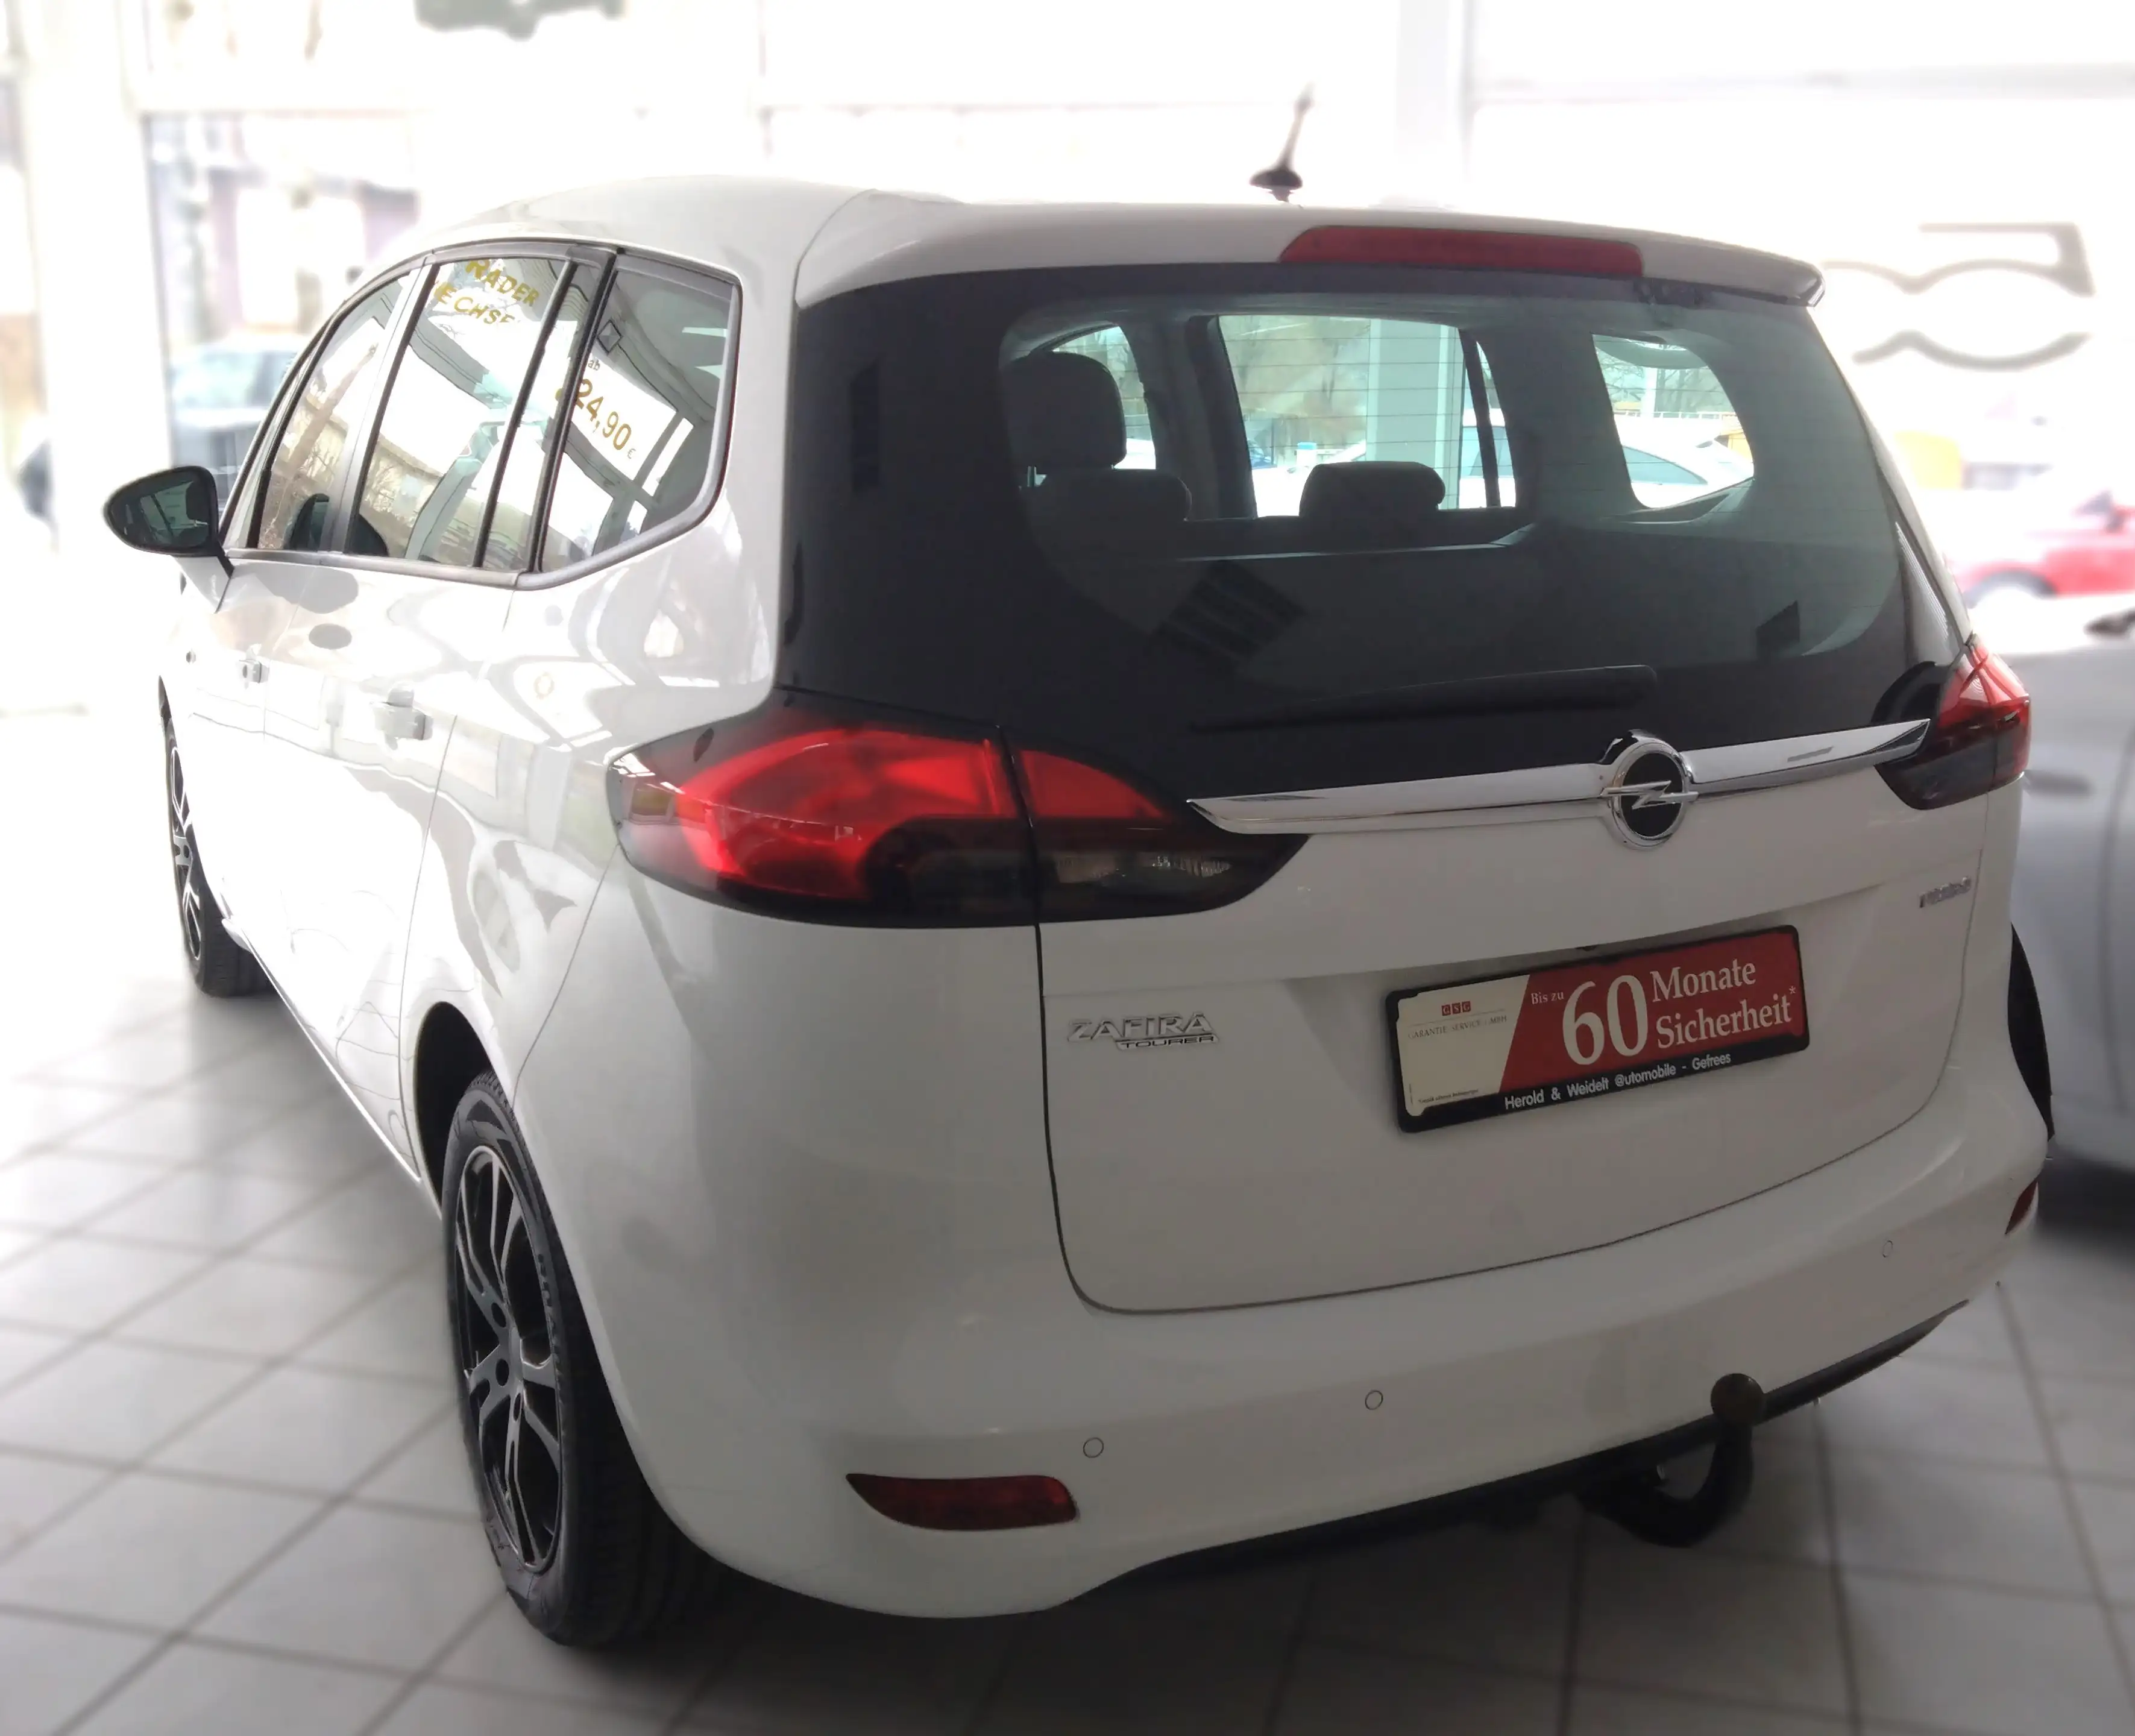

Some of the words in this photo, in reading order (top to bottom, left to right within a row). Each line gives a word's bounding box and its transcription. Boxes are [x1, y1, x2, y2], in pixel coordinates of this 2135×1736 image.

[588, 359, 601, 371] ab
[574, 379, 632, 450] 24,90
[1650, 959, 1756, 1002] Monate
[1067, 1011, 1214, 1042] ZAFIRA
[1408, 1026, 1447, 1040] GARANTIE
[1451, 1019, 1481, 1032] SERVICE
[1485, 1015, 1508, 1027] MBH
[1531, 991, 1549, 1005] Bis
[1551, 991, 1565, 1002] zu
[1562, 975, 1648, 1066] 60
[1121, 1036, 1215, 1049] TOURER
[1505, 1088, 1544, 1110] Herold
[1550, 1087, 1561, 1101] &
[1567, 1077, 1609, 1098] Weidelt
[1614, 1063, 1676, 1087] @utomobile
[1691, 1052, 1731, 1071] Gefrees
